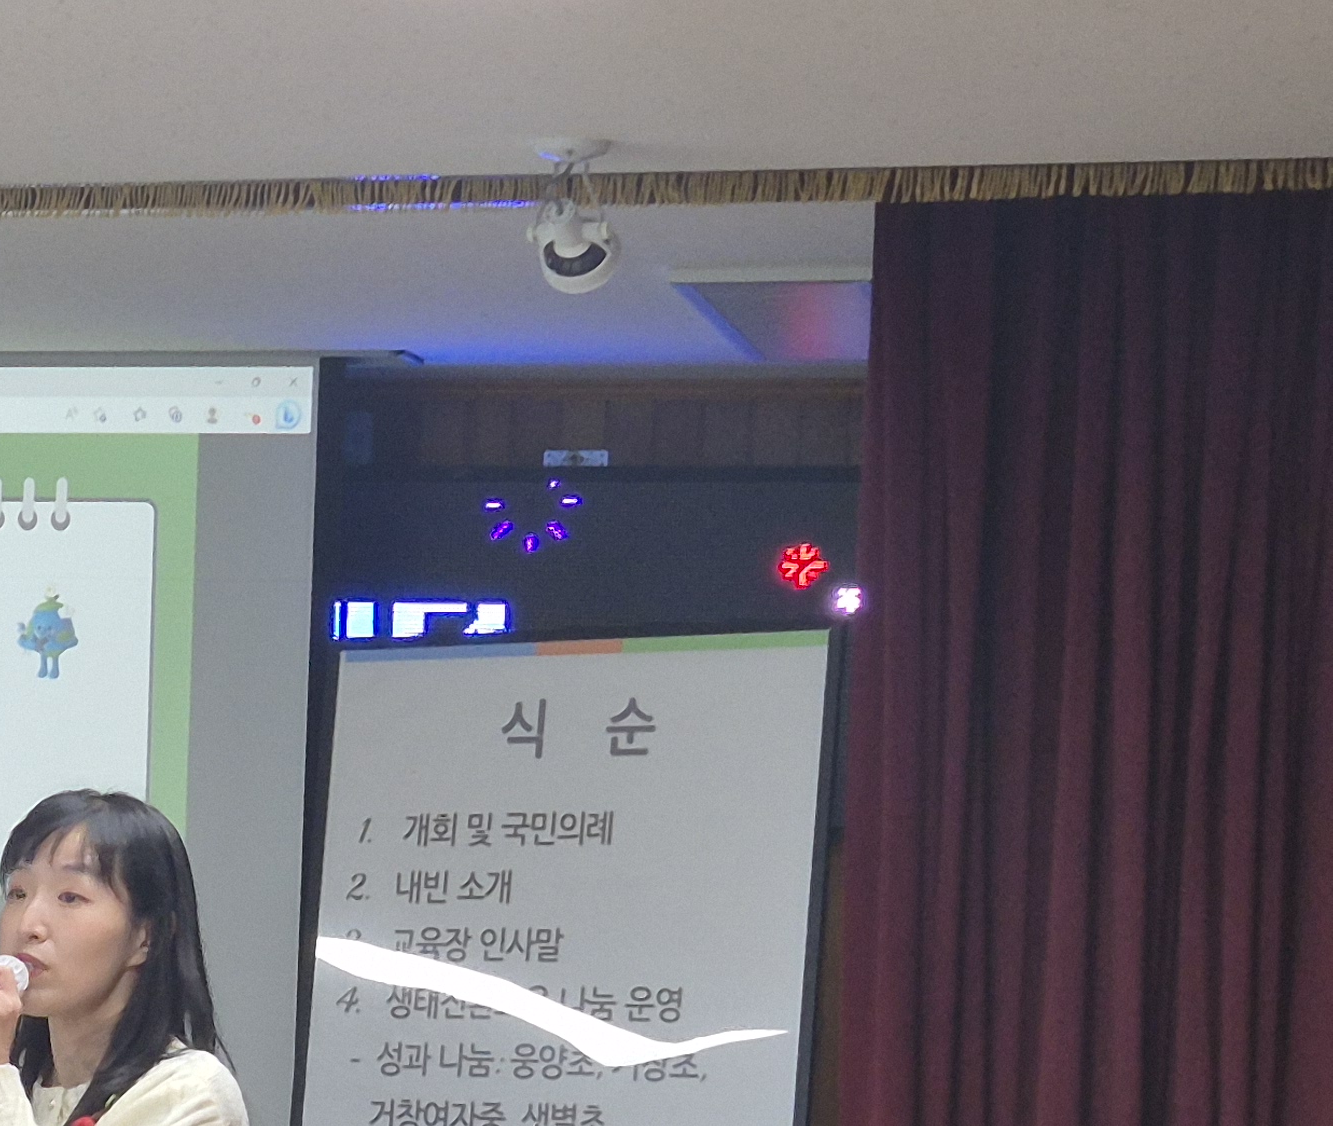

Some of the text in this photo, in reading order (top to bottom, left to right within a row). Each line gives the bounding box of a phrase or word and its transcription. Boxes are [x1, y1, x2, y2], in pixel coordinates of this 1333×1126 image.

[502, 697, 656, 759] 식 순
[359, 811, 614, 847] 1. 개회 및 국민의례
[346, 870, 512, 904] 2. 내빈 소개
[394, 926, 564, 962] 교육장 인사말
[336, 987, 360, 1013] 4.
[625, 986, 682, 1023] 운영
[377, 1042, 431, 1077] 성과
[439, 1043, 504, 1078] 나눔:
[511, 1043, 603, 1081] 웅양초,
